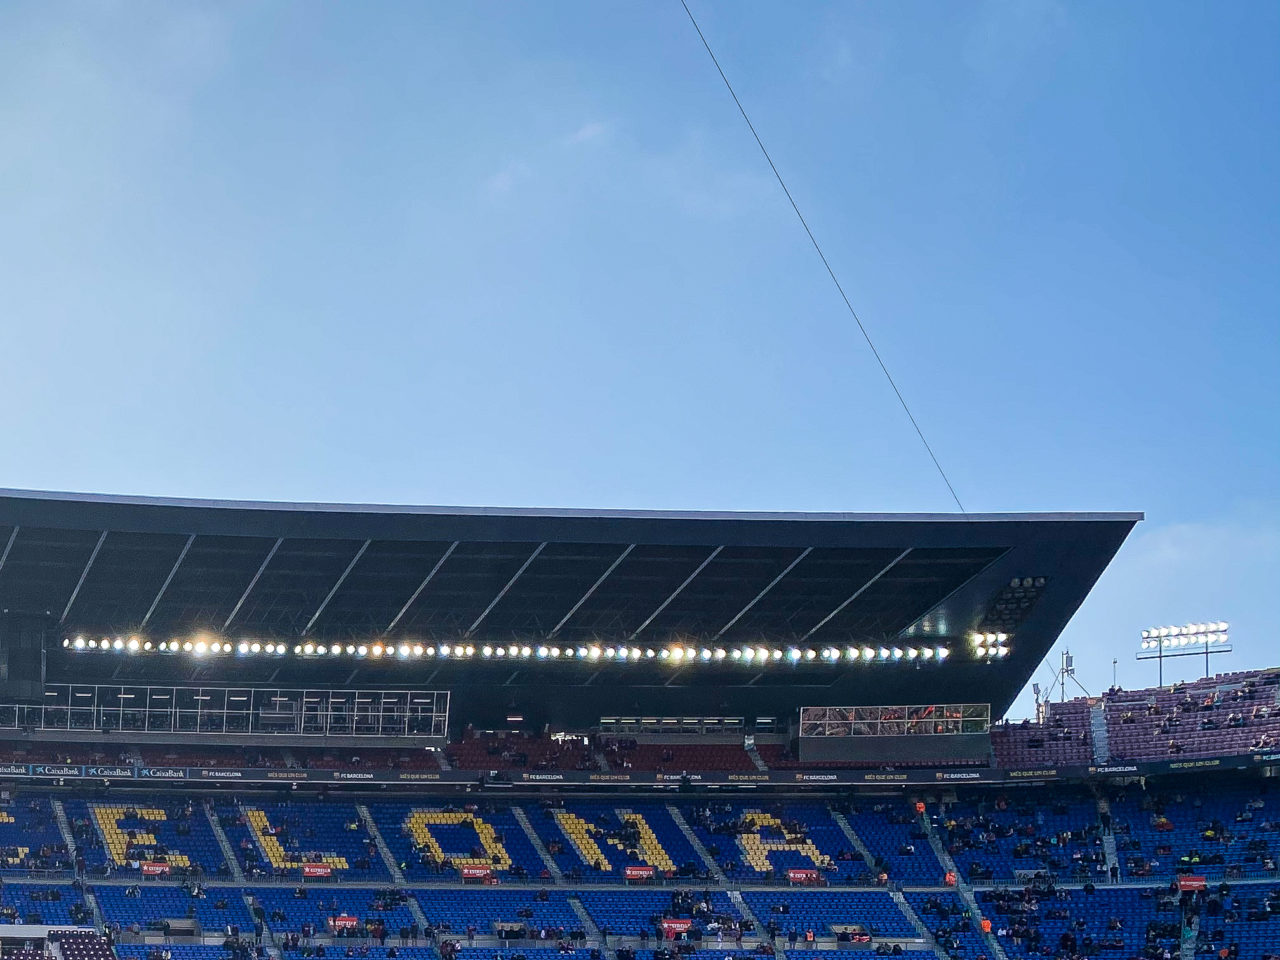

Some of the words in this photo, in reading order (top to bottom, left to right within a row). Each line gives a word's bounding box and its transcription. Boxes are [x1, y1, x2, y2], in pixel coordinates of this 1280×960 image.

[45, 766, 79, 775] CaixaBank
[98, 767, 131, 776] CaixaBank
[151, 768, 184, 777] CaixaBank
